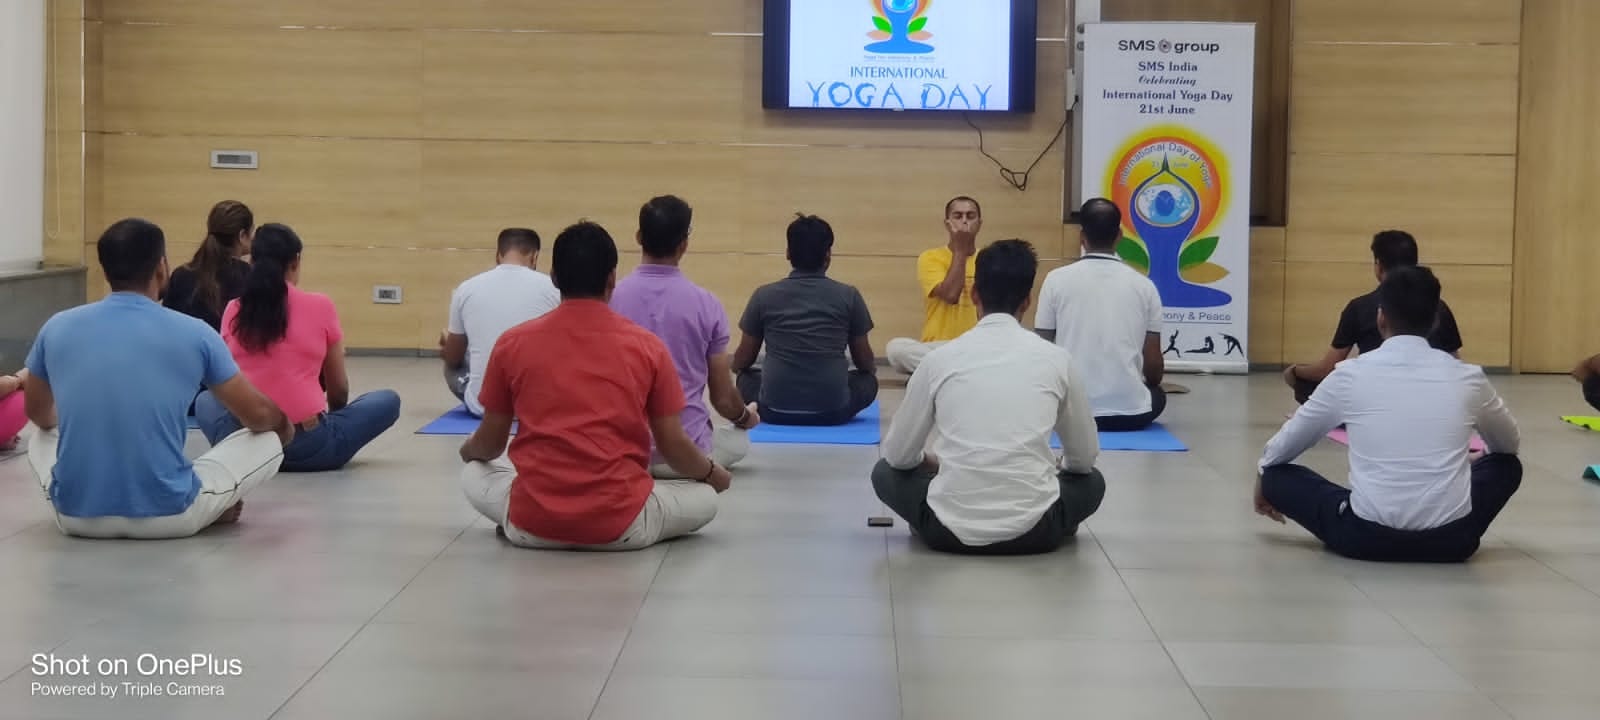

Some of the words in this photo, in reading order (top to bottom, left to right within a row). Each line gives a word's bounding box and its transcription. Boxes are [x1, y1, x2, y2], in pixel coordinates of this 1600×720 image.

[1118, 39, 1155, 51] SMS
[1174, 42, 1220, 54] group
[850, 66, 948, 79] INTERNATIONAL
[1138, 61, 1165, 71] SMS
[1169, 61, 1198, 71] India
[1138, 75, 1197, 86] Celebrating
[807, 81, 905, 108] YOGA
[920, 82, 993, 110] DAY
[1103, 89, 1176, 100] International
[1180, 90, 1207, 102] Yoga
[1211, 91, 1233, 102] Day
[1139, 104, 1164, 114] 21st
[1168, 104, 1196, 114] June
[1119, 142, 1165, 185] International
[1168, 142, 1190, 157] Day
[1189, 153, 1201, 163] of
[1187, 311, 1195, 320] &
[1198, 311, 1231, 321] Peace
